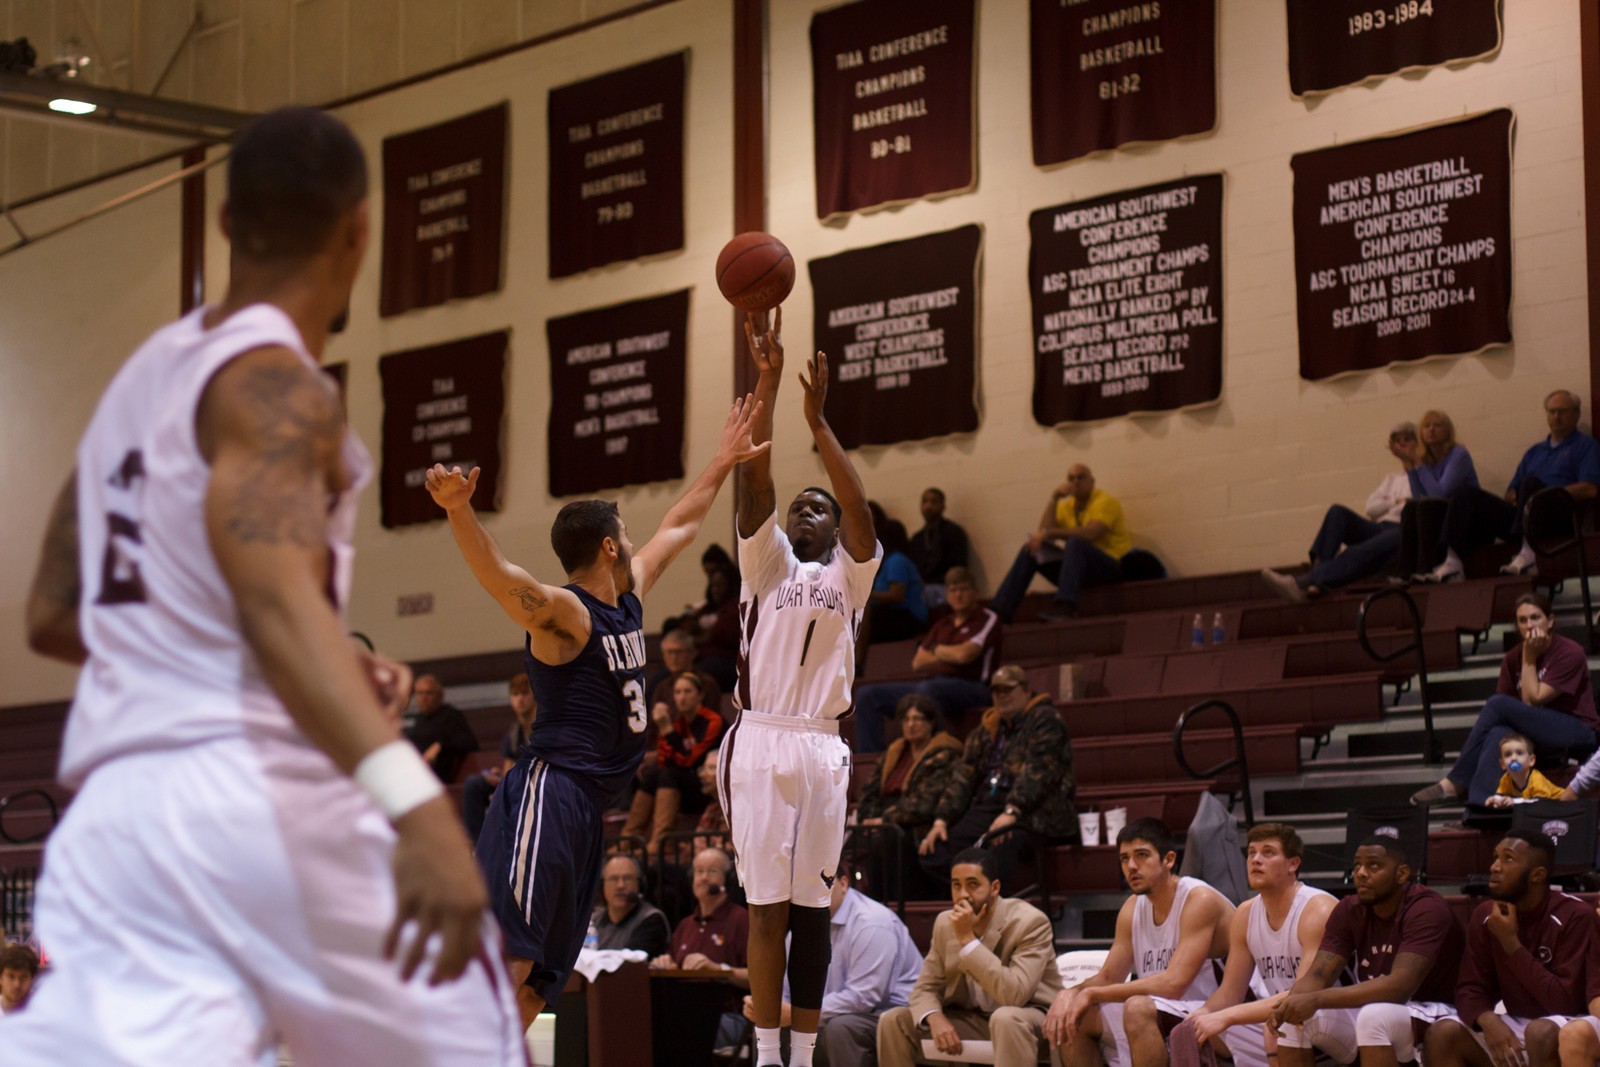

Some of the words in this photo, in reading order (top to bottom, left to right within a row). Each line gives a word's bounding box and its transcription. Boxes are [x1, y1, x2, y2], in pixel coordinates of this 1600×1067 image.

[1082, 2, 1161, 37] CHAMPIONS
[1349, 0, 1433, 36] 1983-1984
[869, 24, 949, 63] CONFERENCE
[1079, 35, 1164, 71] BASKETBALL
[855, 65, 926, 99] CHAMPIONS
[852, 98, 928, 132] BASKETBALL
[1328, 176, 1371, 203] MEN'S
[1376, 157, 1470, 193] BASKETBALL
[1053, 203, 1117, 232] AMERICAN
[1118, 186, 1198, 219] SOUTHWEST
[1320, 195, 1391, 226] AMERICAN
[1395, 174, 1484, 210] SOUTHWEST
[1079, 213, 1168, 246] CONFERENCE
[1354, 204, 1449, 240] CONFERENCE
[1087, 235, 1160, 264] CHAMPIONS
[1360, 226, 1443, 259] CHAMPIONS
[1042, 272, 1067, 293] ASC
[1069, 257, 1154, 288] TOURNAMENT
[1156, 244, 1210, 271] CHAMPS
[1310, 270, 1337, 293] ASC
[1340, 251, 1435, 285] TOURNAMENT
[1437, 238, 1496, 266] CHAMPS
[1068, 286, 1102, 307] NCAA
[1105, 277, 1142, 301] ELITE
[1145, 271, 1184, 294] EIGHT
[1350, 282, 1387, 304] NCAA
[1391, 269, 1441, 293] SWEET
[1443, 269, 1456, 286] 16
[828, 301, 885, 328] AMERICAN
[888, 286, 960, 317] SOUTHWEST
[1043, 301, 1118, 331] NATIONALLY
[1119, 293, 1172, 318] RANKED
[1191, 286, 1209, 306] BY
[1332, 301, 1388, 329] SEASON
[1392, 289, 1449, 316] RECORD
[1377, 312, 1431, 338] 2000-2001
[855, 312, 930, 341] CONFERENCE
[1038, 325, 1103, 353] COLUMBUS
[1106, 312, 1179, 342] MULTIMEDIA
[1181, 306, 1218, 329] POLL
[874, 348, 948, 375] BASKETBALL
[1062, 343, 1114, 366] SEASON
[1116, 334, 1166, 358] RECORD
[1104, 352, 1185, 381] BASKETBALL
[776, 583, 803, 610] WAR
[800, 618, 817, 667] 1
[622, 677, 647, 733] 3
